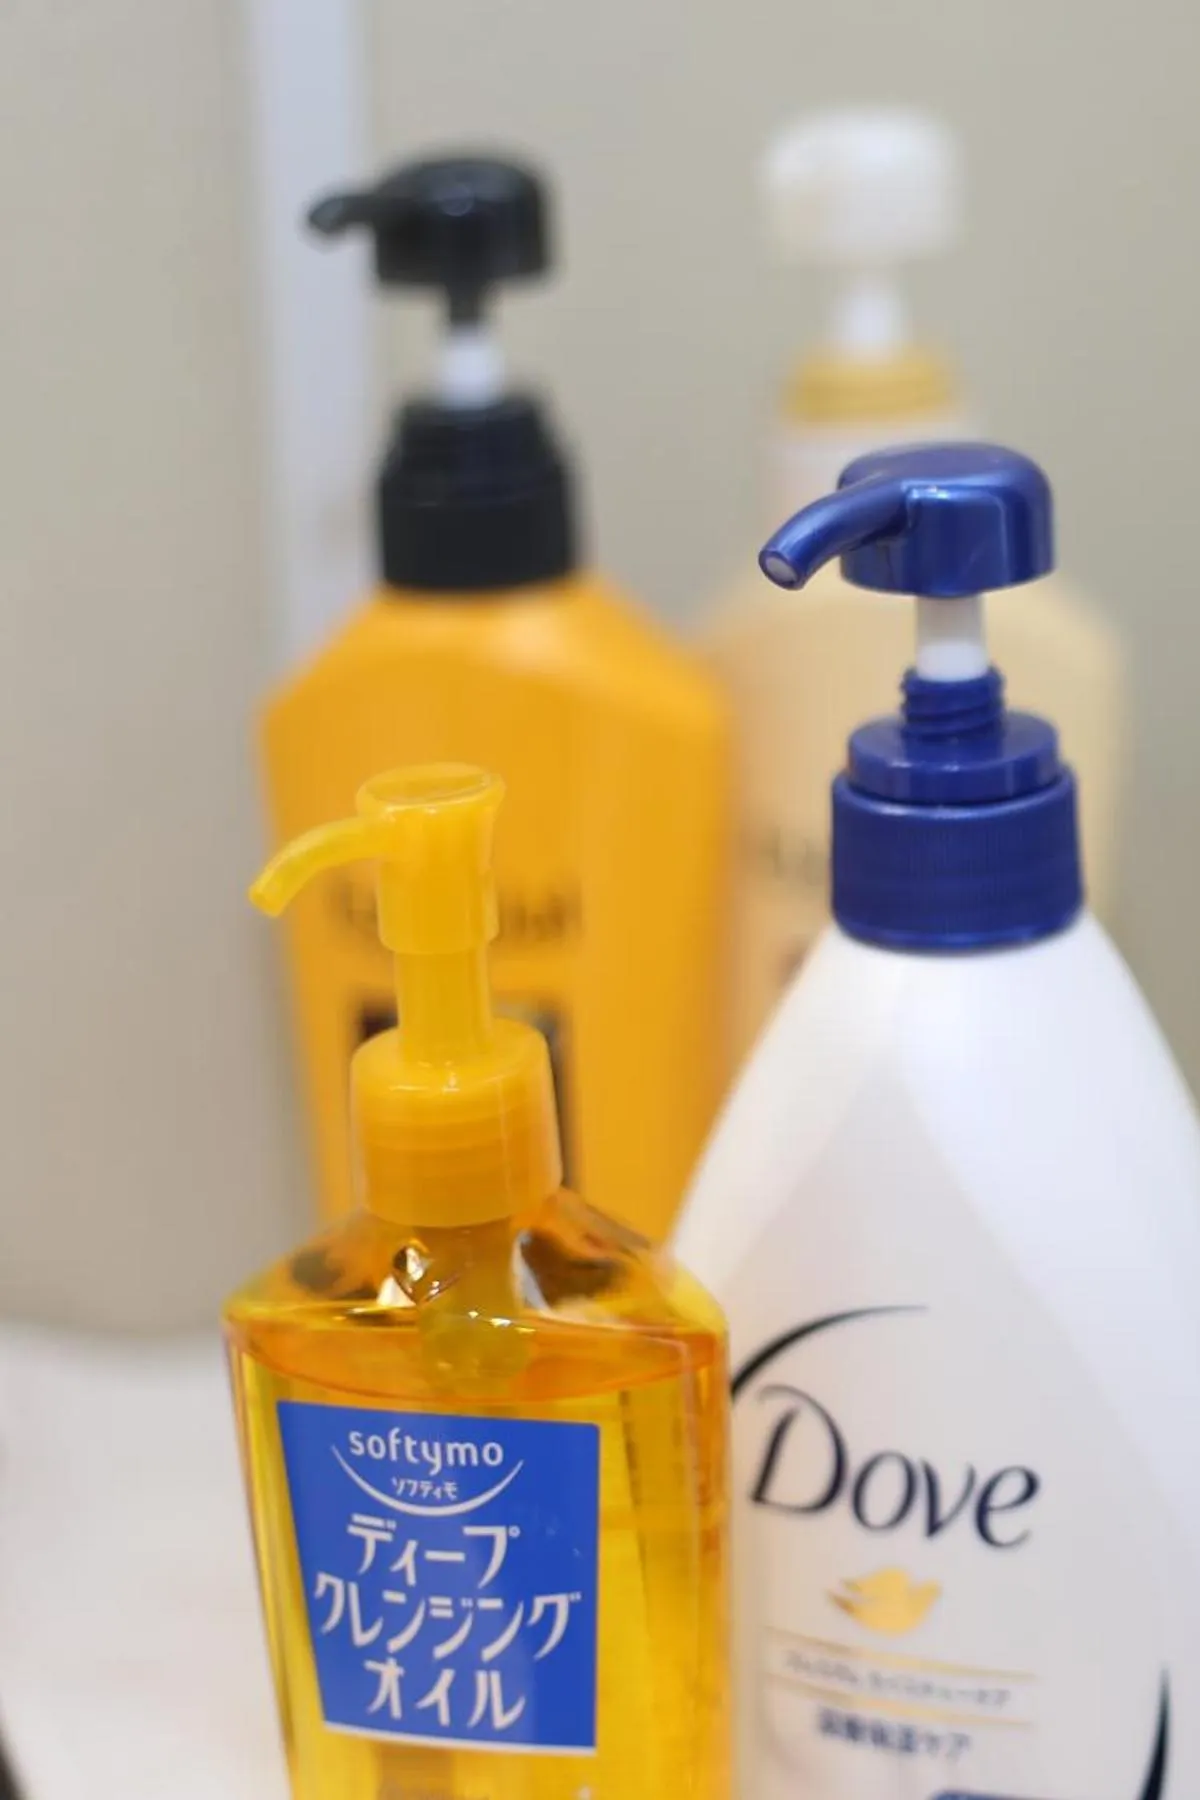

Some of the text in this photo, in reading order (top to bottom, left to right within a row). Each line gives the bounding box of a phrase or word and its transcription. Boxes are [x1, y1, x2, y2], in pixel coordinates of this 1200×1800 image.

[347, 1427, 504, 1476] softymo
[390, 1476, 458, 1501] ソフティモ
[750, 1384, 1040, 1549] Dove
[346, 1513, 521, 1589] ディープ
[314, 1572, 582, 1663] クレンジング
[364, 1657, 526, 1731] オイル
